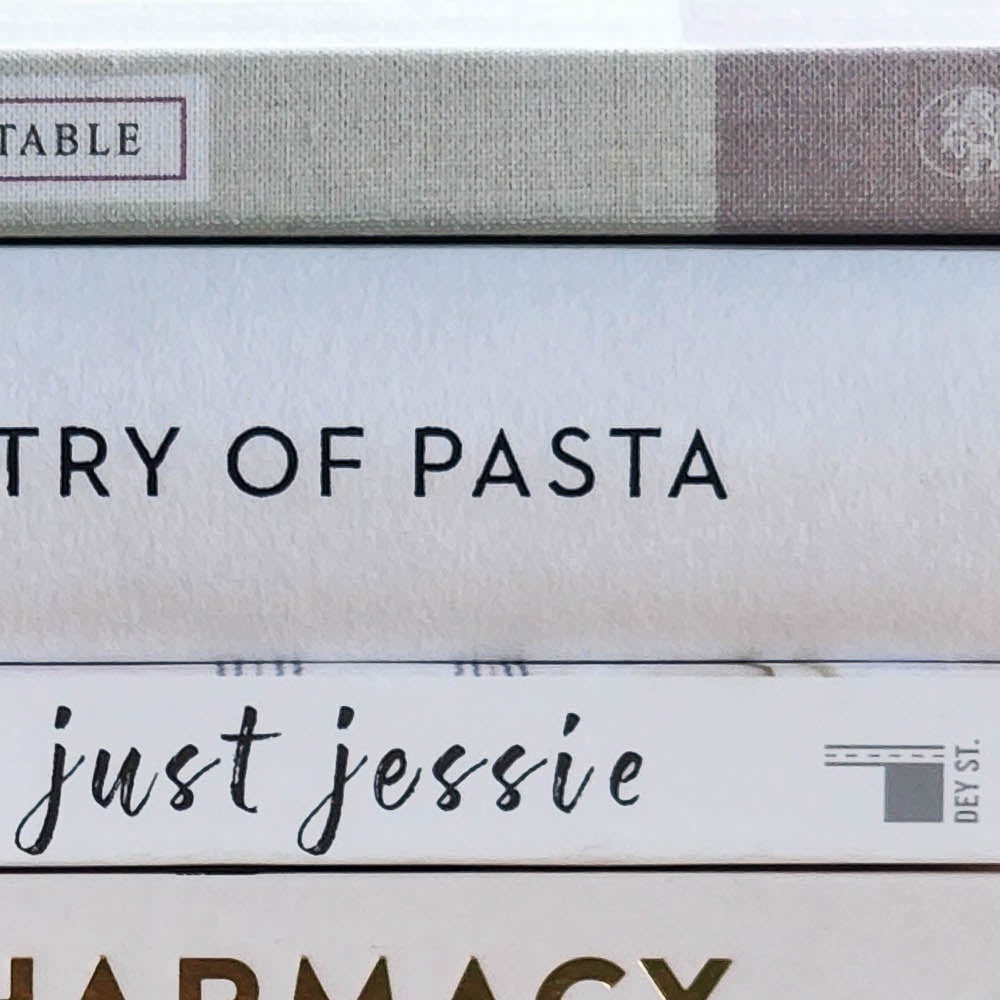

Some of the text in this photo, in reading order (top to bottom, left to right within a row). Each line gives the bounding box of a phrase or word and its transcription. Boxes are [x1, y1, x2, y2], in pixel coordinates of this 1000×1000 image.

[227, 426, 363, 497] OF
[414, 426, 727, 499] PASTA
[15, 705, 644, 856] just jessie
[954, 738, 980, 823] DEY ST.
